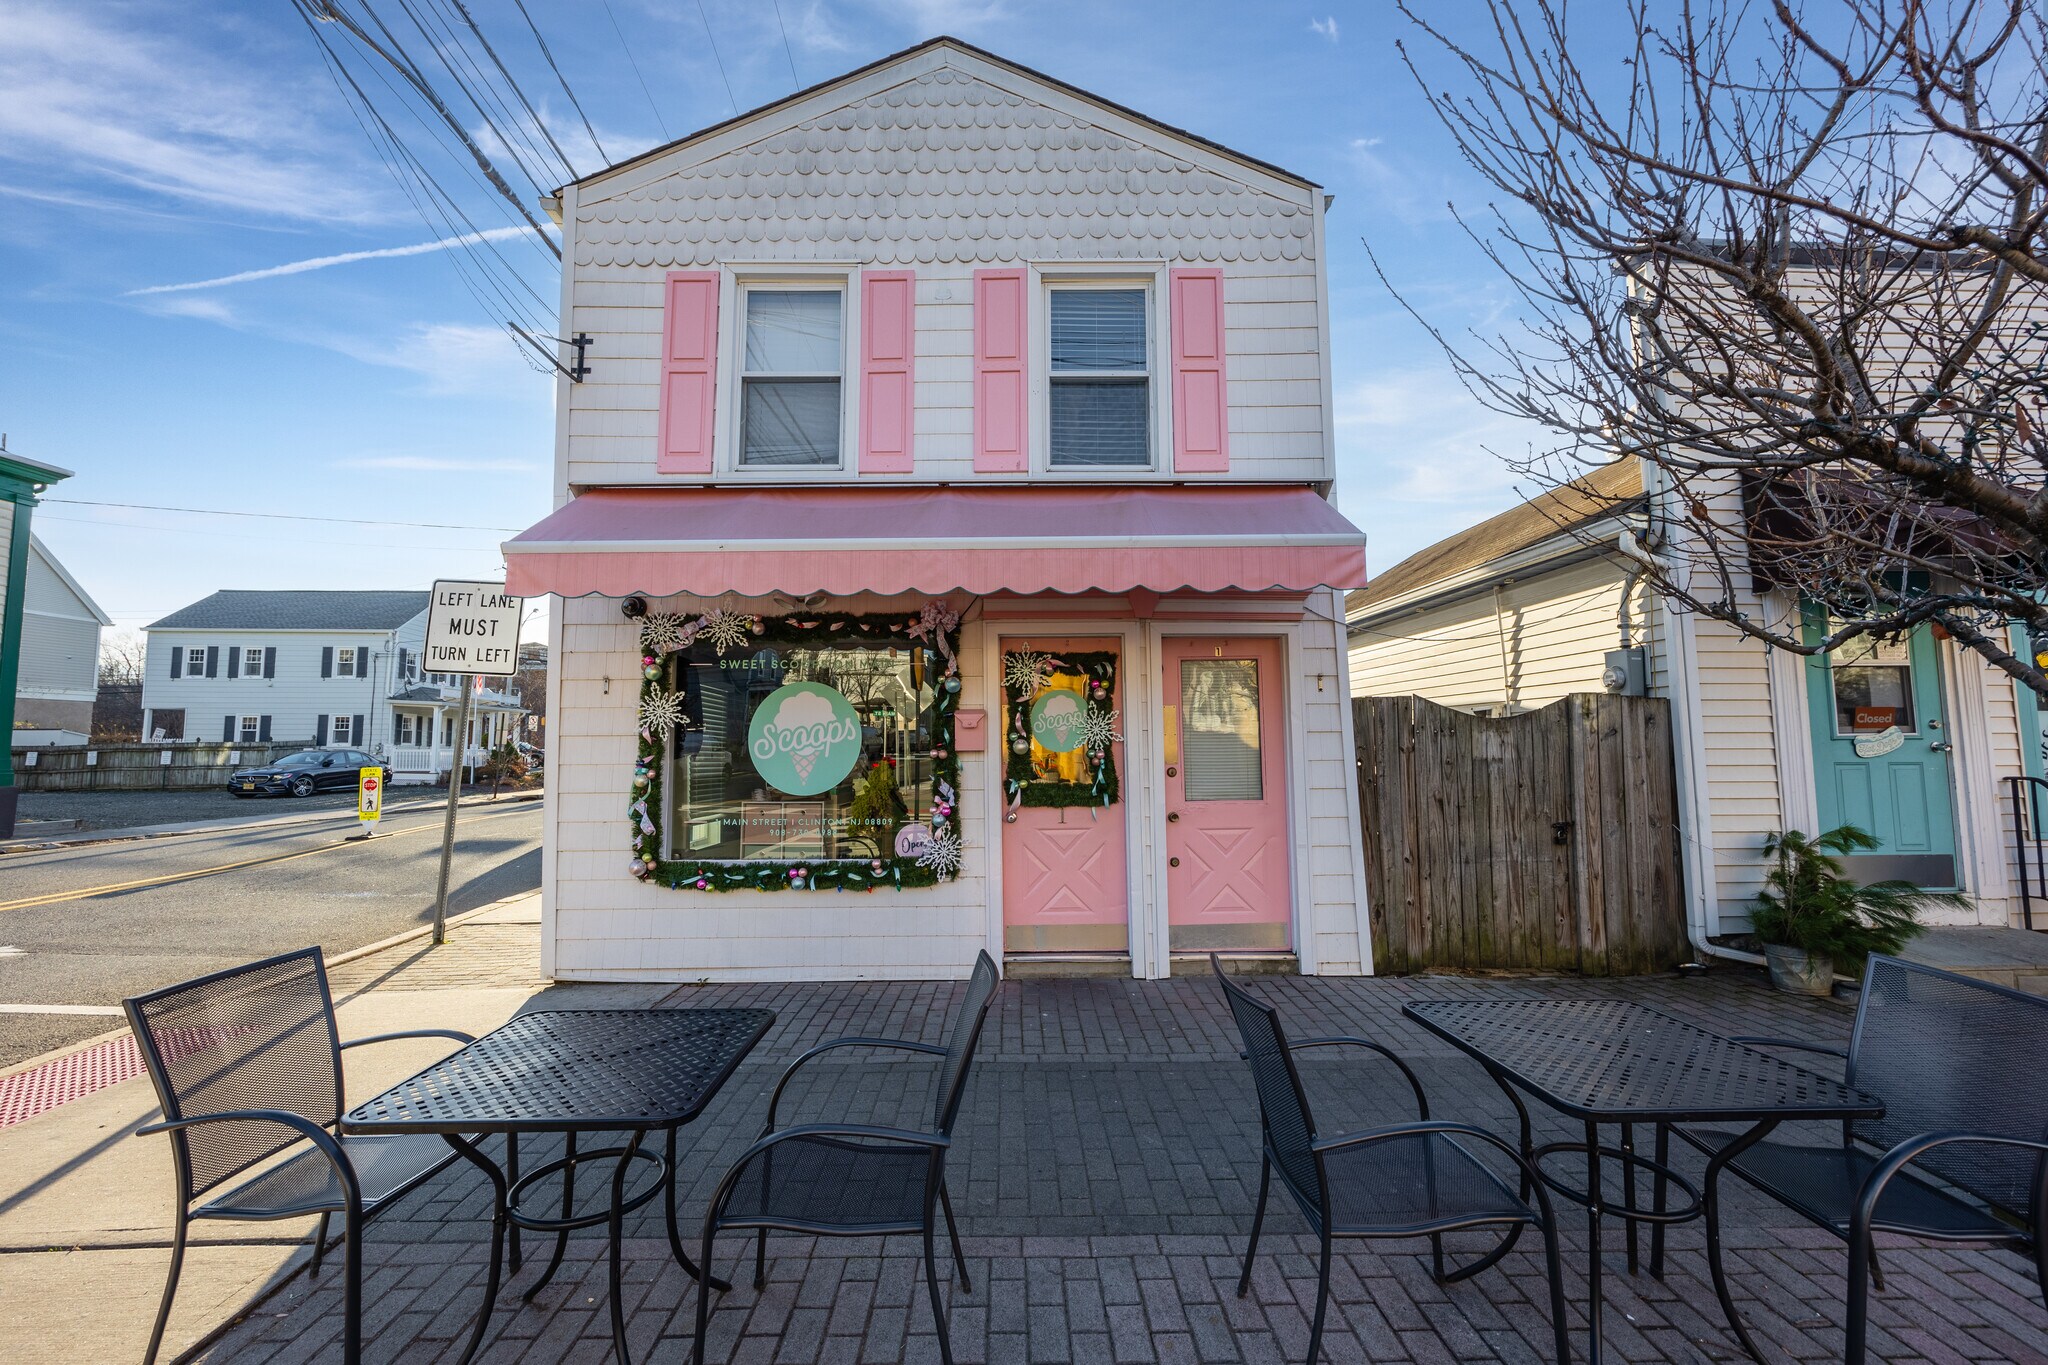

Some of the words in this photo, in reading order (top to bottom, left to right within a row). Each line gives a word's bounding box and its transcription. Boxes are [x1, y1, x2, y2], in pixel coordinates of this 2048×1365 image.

[440, 592, 473, 606] LEFT
[481, 594, 515, 608] LANE
[449, 618, 499, 636] MUST
[432, 646, 466, 661] TURN
[477, 648, 510, 663] LEFT
[720, 660, 766, 669] SWEET
[1856, 713, 1892, 723] Closed
[754, 718, 856, 759] Scoops
[723, 818, 749, 826] MAIN
[752, 818, 787, 826] STREET
[850, 818, 861, 826] NJ
[864, 818, 893, 826] 08809
